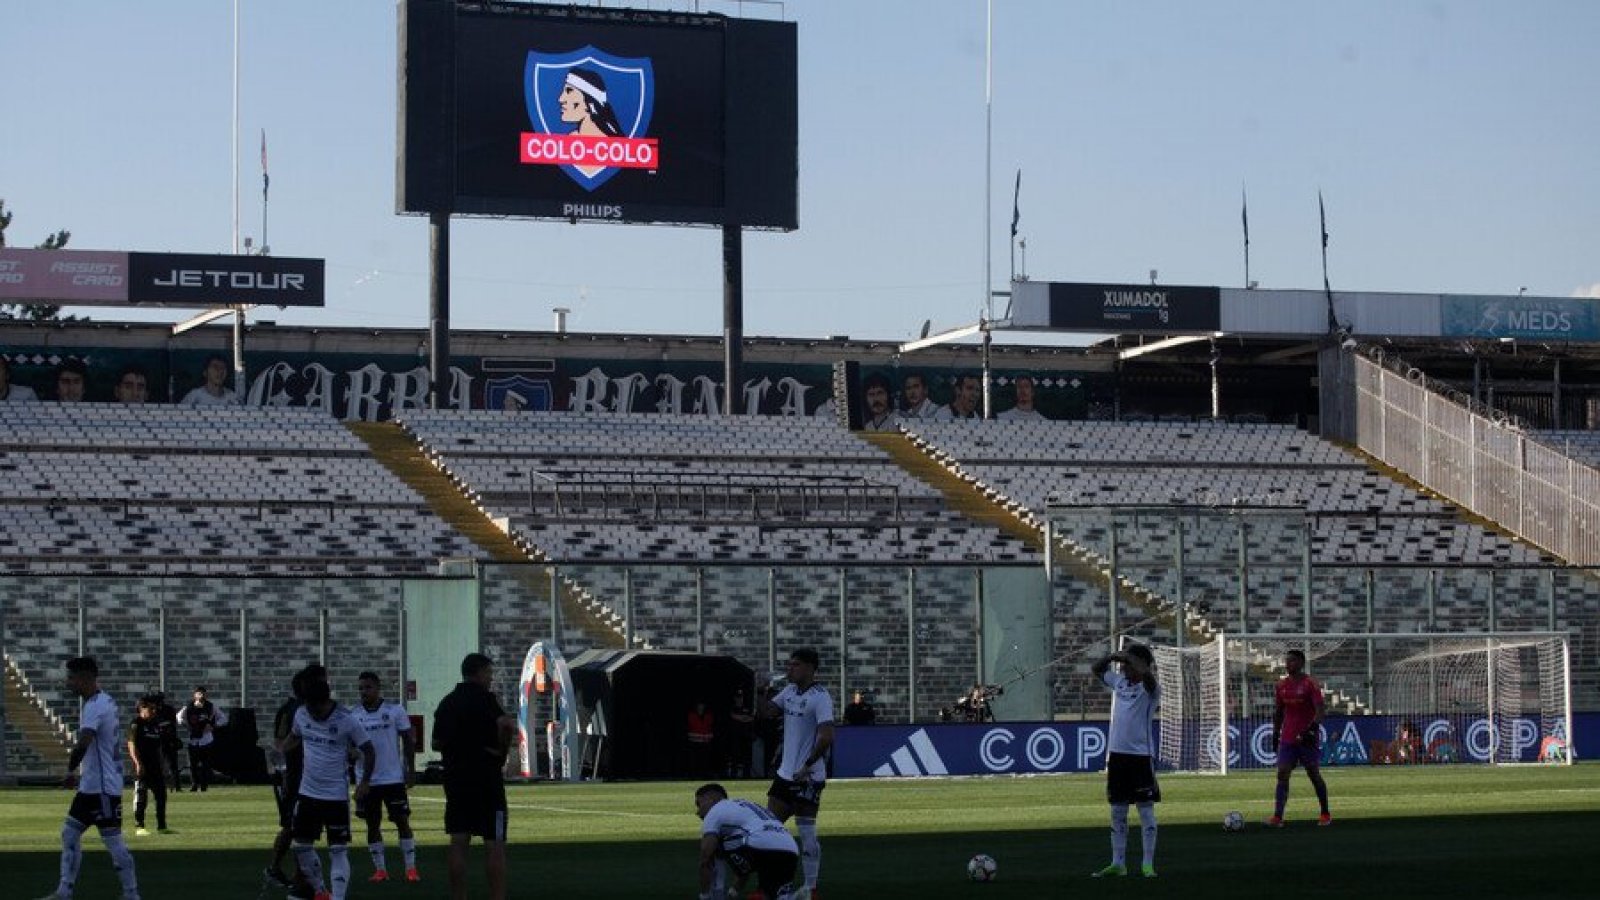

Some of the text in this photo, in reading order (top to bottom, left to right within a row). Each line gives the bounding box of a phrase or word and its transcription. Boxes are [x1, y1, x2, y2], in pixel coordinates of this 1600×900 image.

[527, 138, 652, 163] COLO-COLO
[563, 203, 622, 218] PHILIPS
[50, 261, 119, 274] ASSIST
[72, 273, 122, 286] CARD
[153, 269, 305, 291] JETOUR
[1103, 290, 1169, 308] XUMADOL
[1507, 310, 1571, 332] MEDS
[979, 726, 1108, 771] COP
